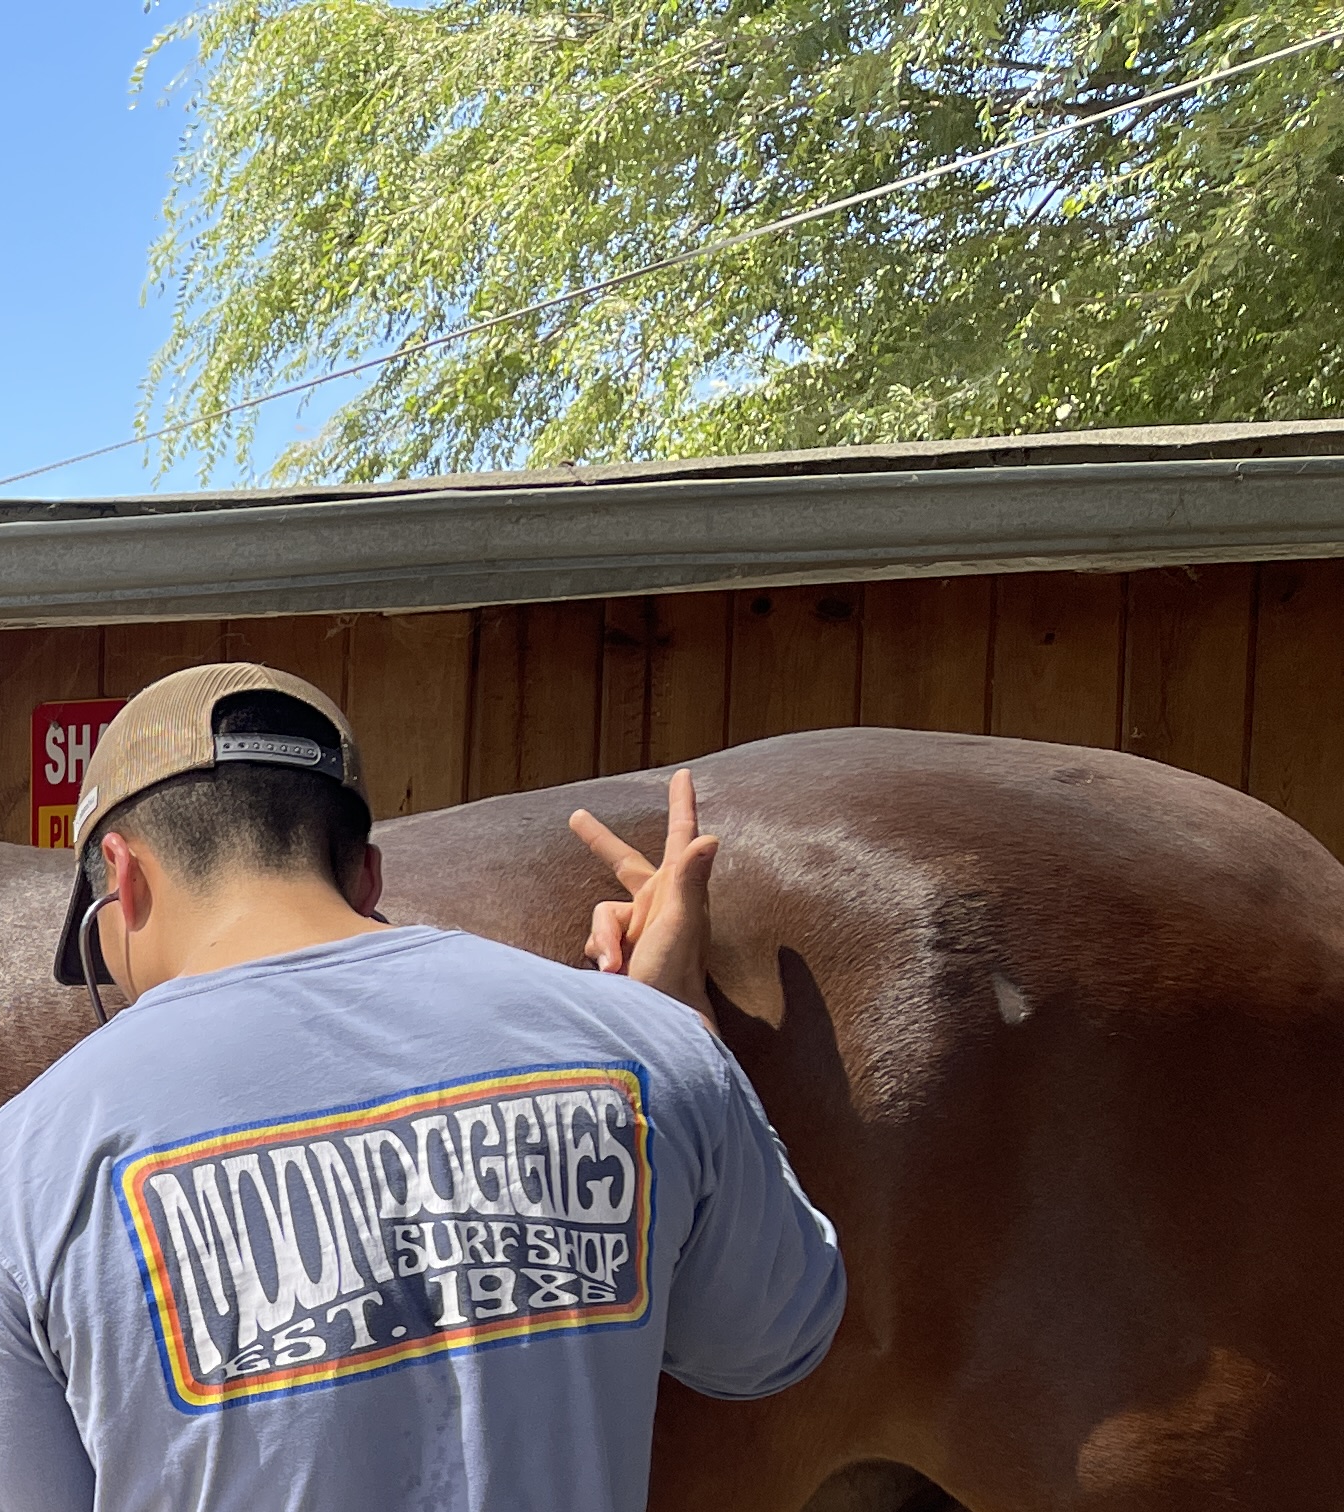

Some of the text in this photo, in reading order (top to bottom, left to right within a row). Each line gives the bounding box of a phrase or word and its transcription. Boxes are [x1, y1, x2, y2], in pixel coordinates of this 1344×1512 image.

[149, 1089, 636, 1375] MOONDOGGIES
[394, 1219, 629, 1289] SURF SHOP
[223, 1266, 617, 1379] EST. 1986
